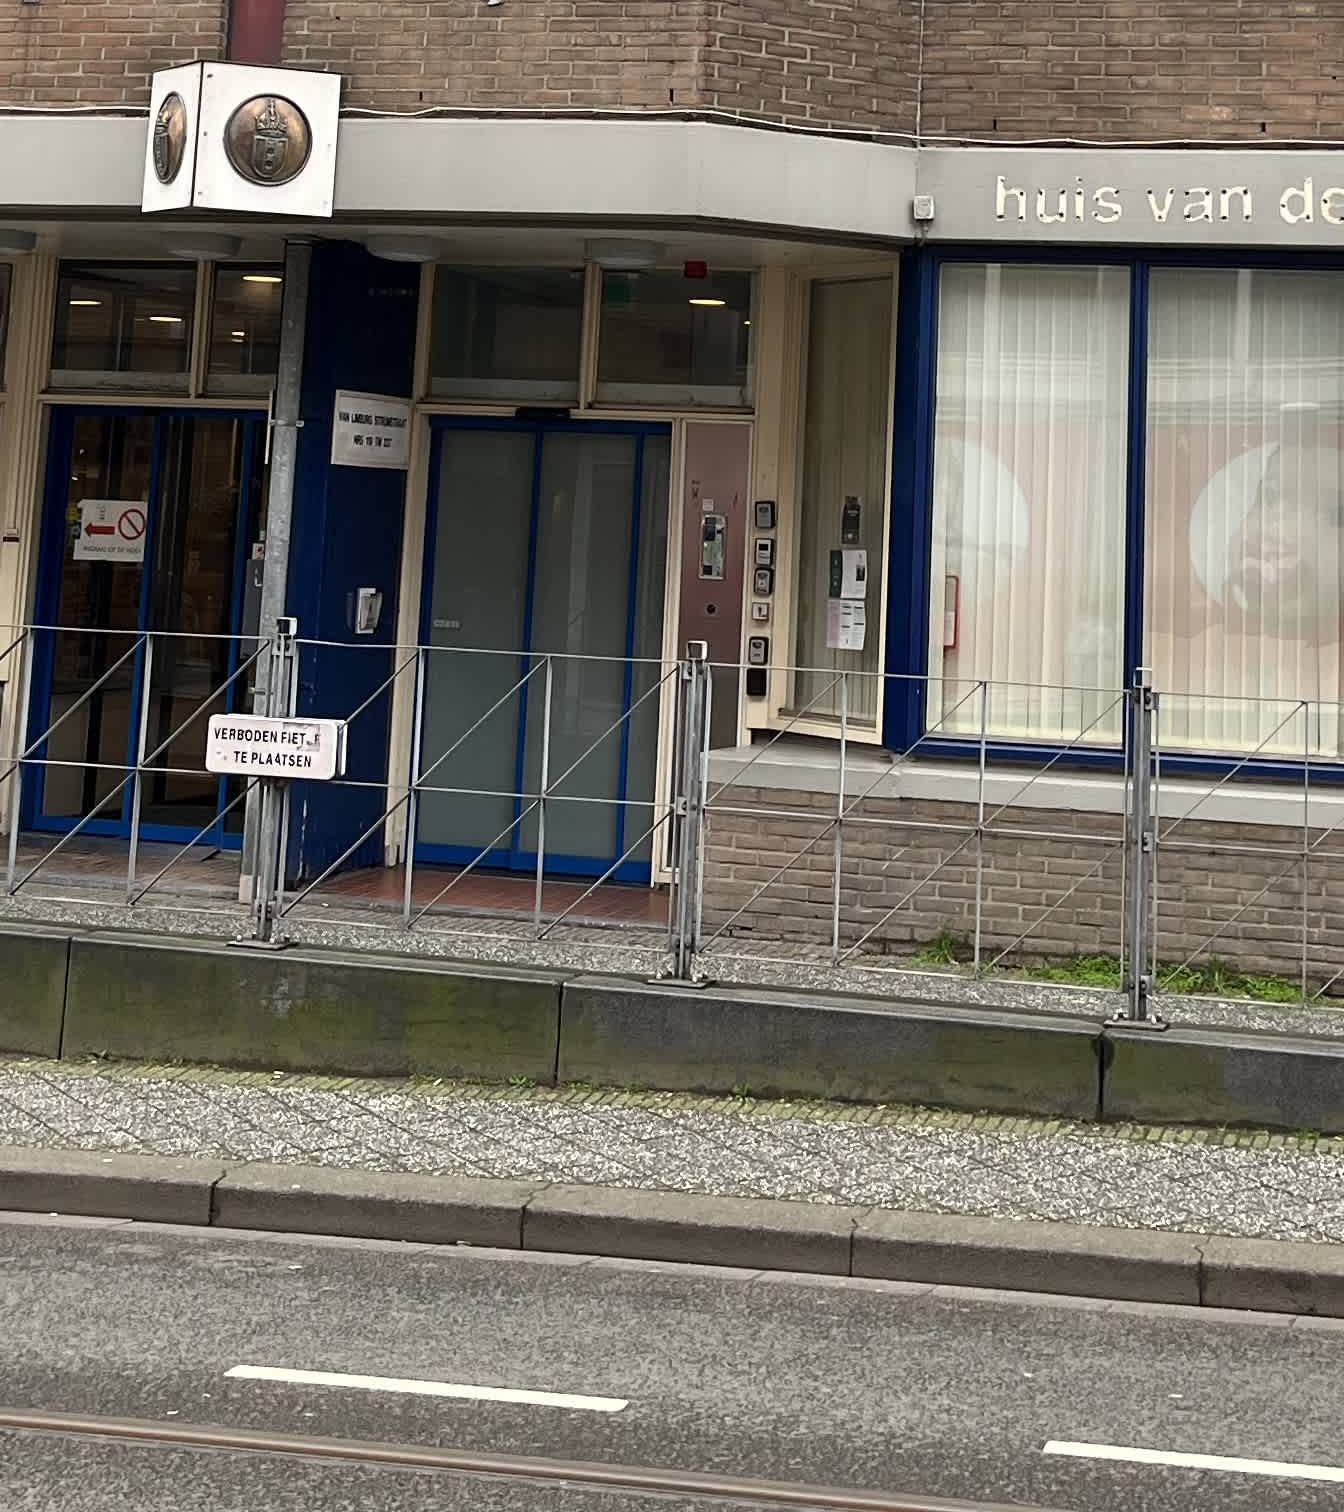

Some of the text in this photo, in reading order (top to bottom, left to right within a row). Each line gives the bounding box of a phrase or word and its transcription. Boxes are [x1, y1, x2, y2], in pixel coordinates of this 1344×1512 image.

[996, 175, 1123, 224] huis
[1146, 187, 1254, 224] van
[214, 727, 277, 743] VERBODEN
[233, 750, 312, 768] TE PLAATSEN
